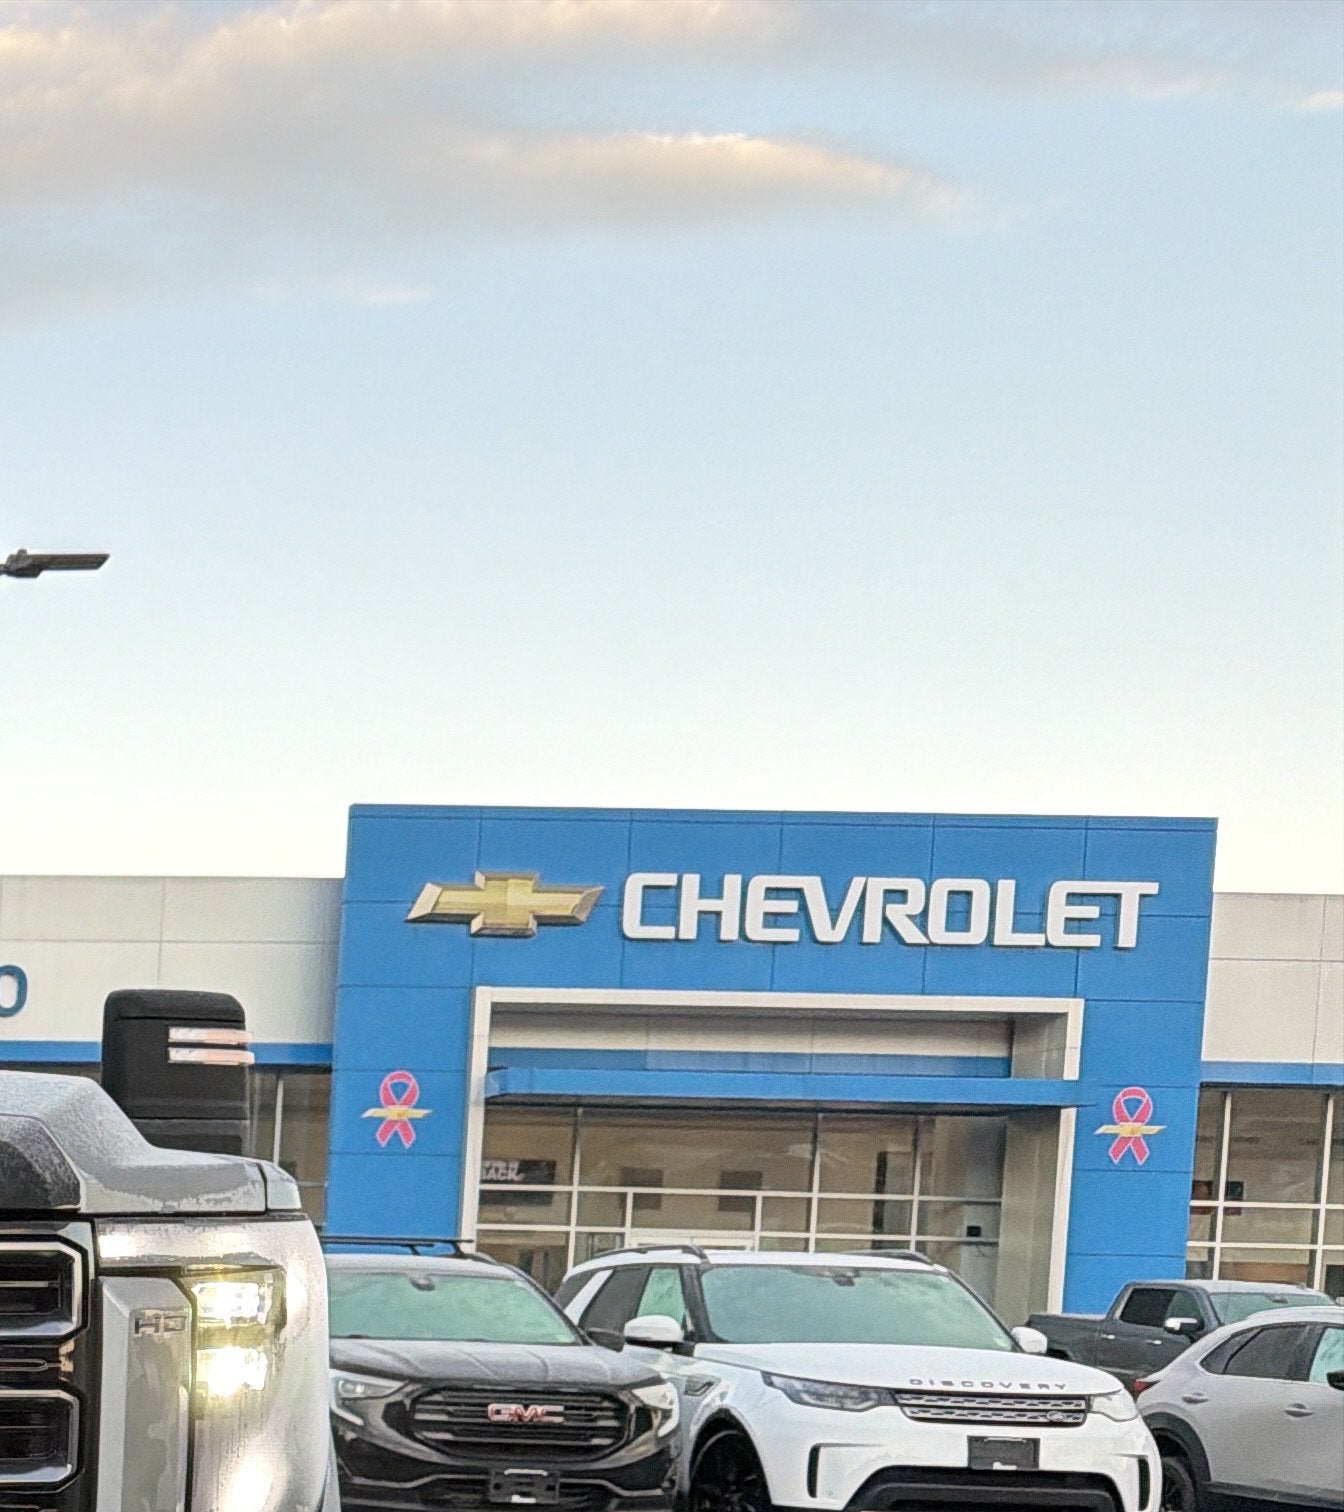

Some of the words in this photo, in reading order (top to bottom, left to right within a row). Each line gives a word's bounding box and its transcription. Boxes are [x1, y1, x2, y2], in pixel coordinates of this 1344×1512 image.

[622, 872, 1160, 948] CHEVROLET
[134, 1315, 187, 1334] HD
[909, 1378, 1066, 1390] DISCOVERY
[488, 1403, 565, 1423] GMC
